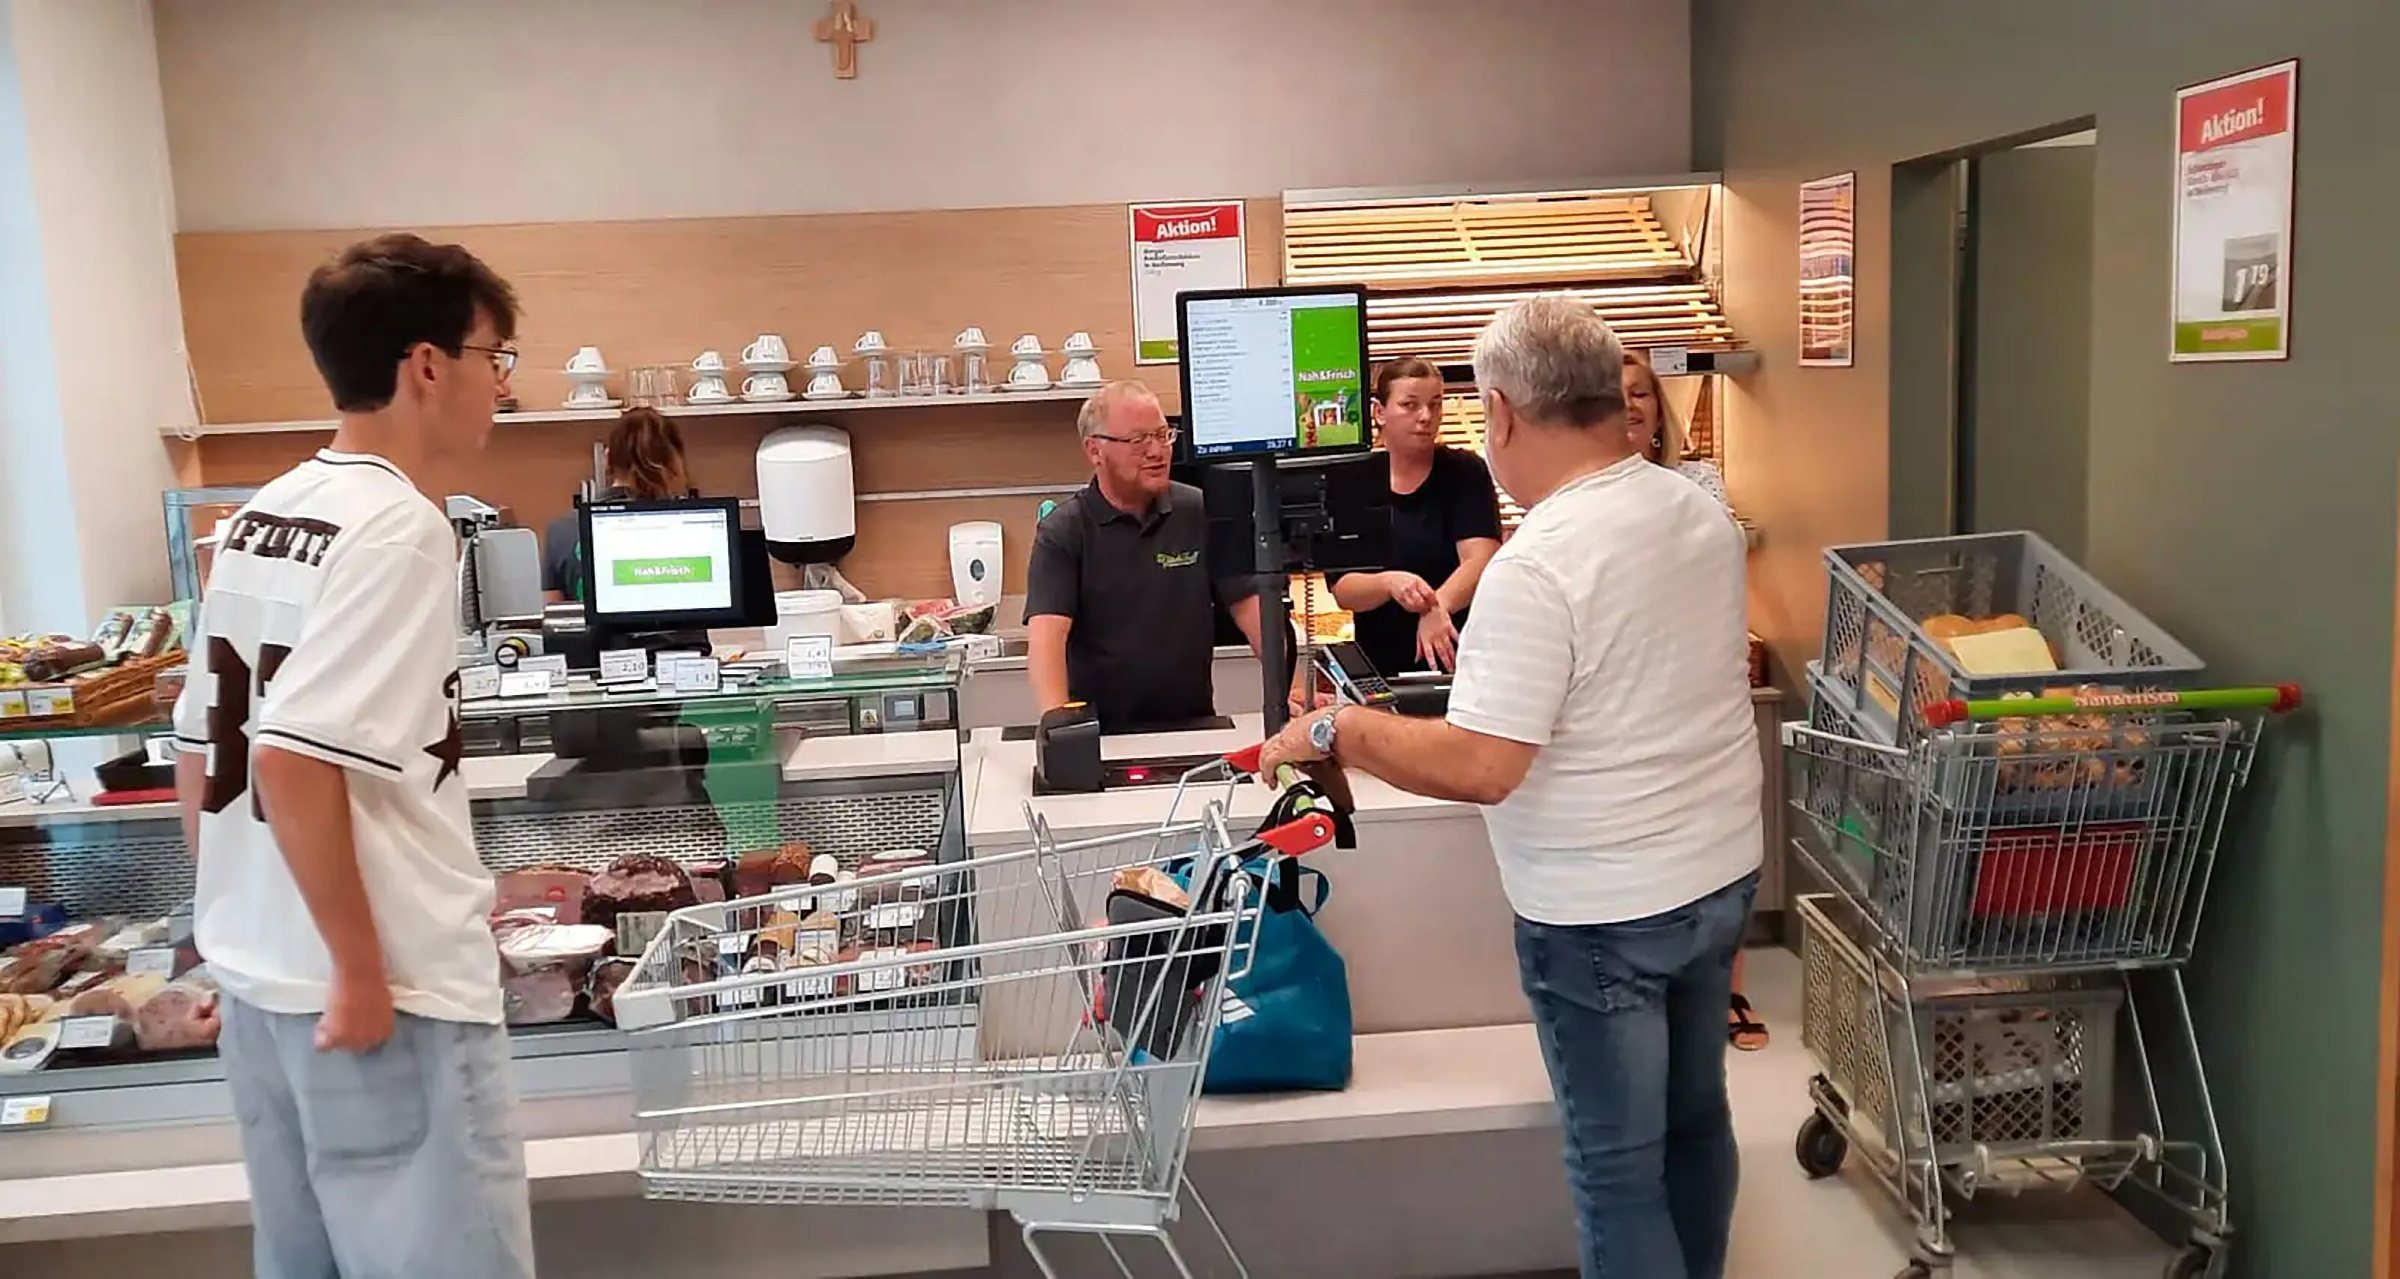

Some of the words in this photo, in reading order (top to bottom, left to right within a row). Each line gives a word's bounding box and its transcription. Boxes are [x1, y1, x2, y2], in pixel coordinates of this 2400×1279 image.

[2200, 97, 2265, 145] Aktion!
[1156, 215, 1217, 240] Aktion!
[1298, 369, 1356, 382] Nah&Frisch
[633, 564, 692, 577] Nah&Frisch
